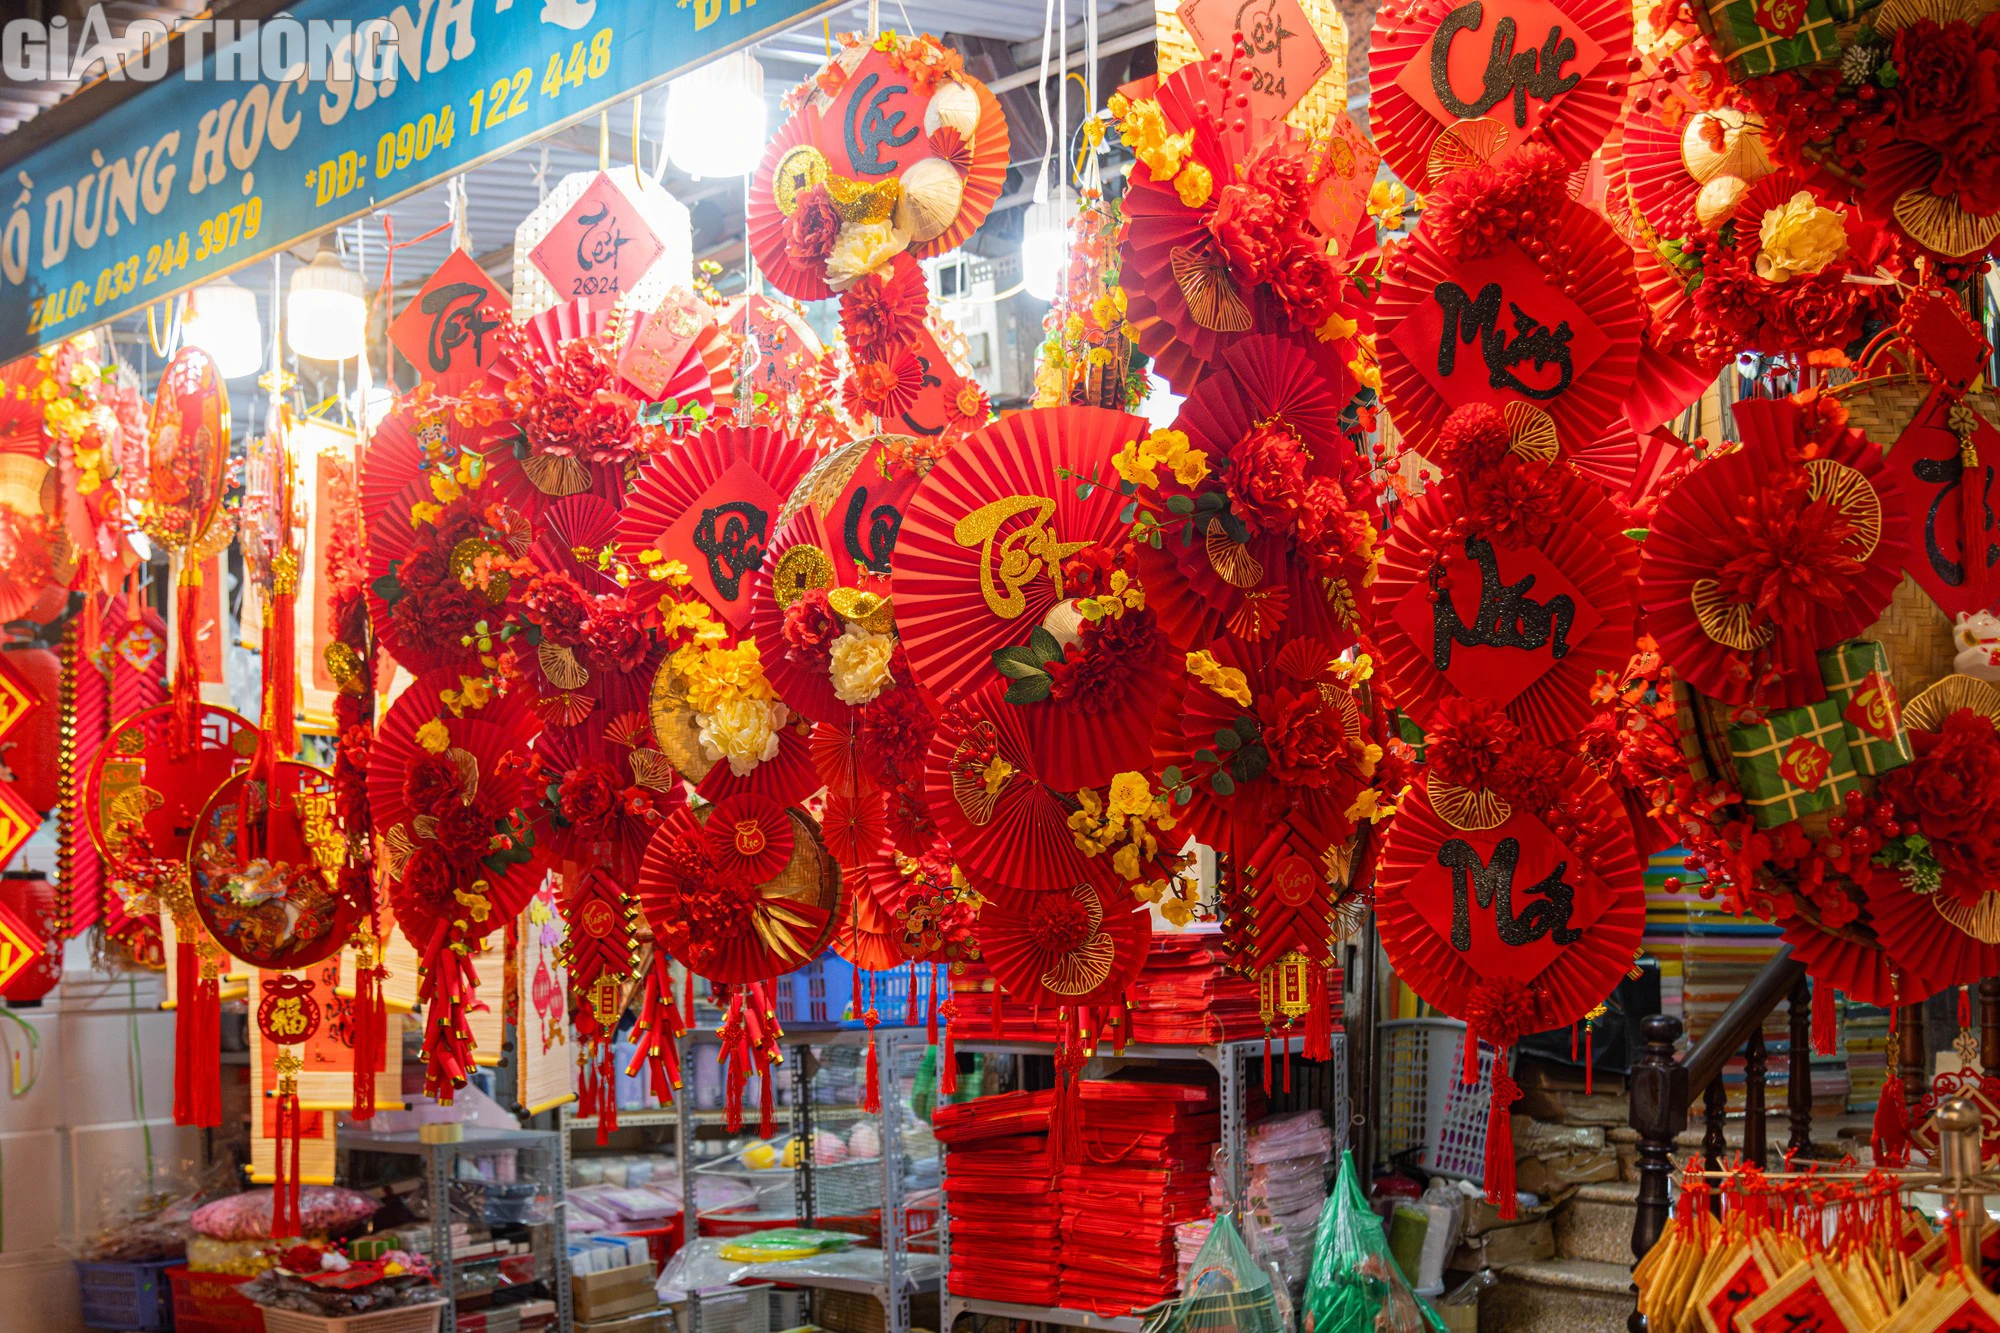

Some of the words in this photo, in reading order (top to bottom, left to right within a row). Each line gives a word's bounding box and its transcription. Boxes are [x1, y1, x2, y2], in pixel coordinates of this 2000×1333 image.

[0, 171, 32, 286] Ồ
[42, 130, 181, 270] DÙNG
[188, 62, 310, 196] HỌC
[320, 0, 476, 126] SINH
[26, 280, 91, 336] ZALO:
[95, 256, 140, 306] 033
[142, 231, 191, 286] 244
[195, 196, 262, 261] 3979
[375, 105, 455, 180] 0904
[469, 67, 532, 136] 122
[541, 28, 613, 99] 448
[577, 200, 632, 271] Tết
[421, 282, 500, 373] Tết
[954, 494, 1098, 619] Tết
[1787, 746, 1821, 783] Tết
[270, 997, 308, 1037] 福
